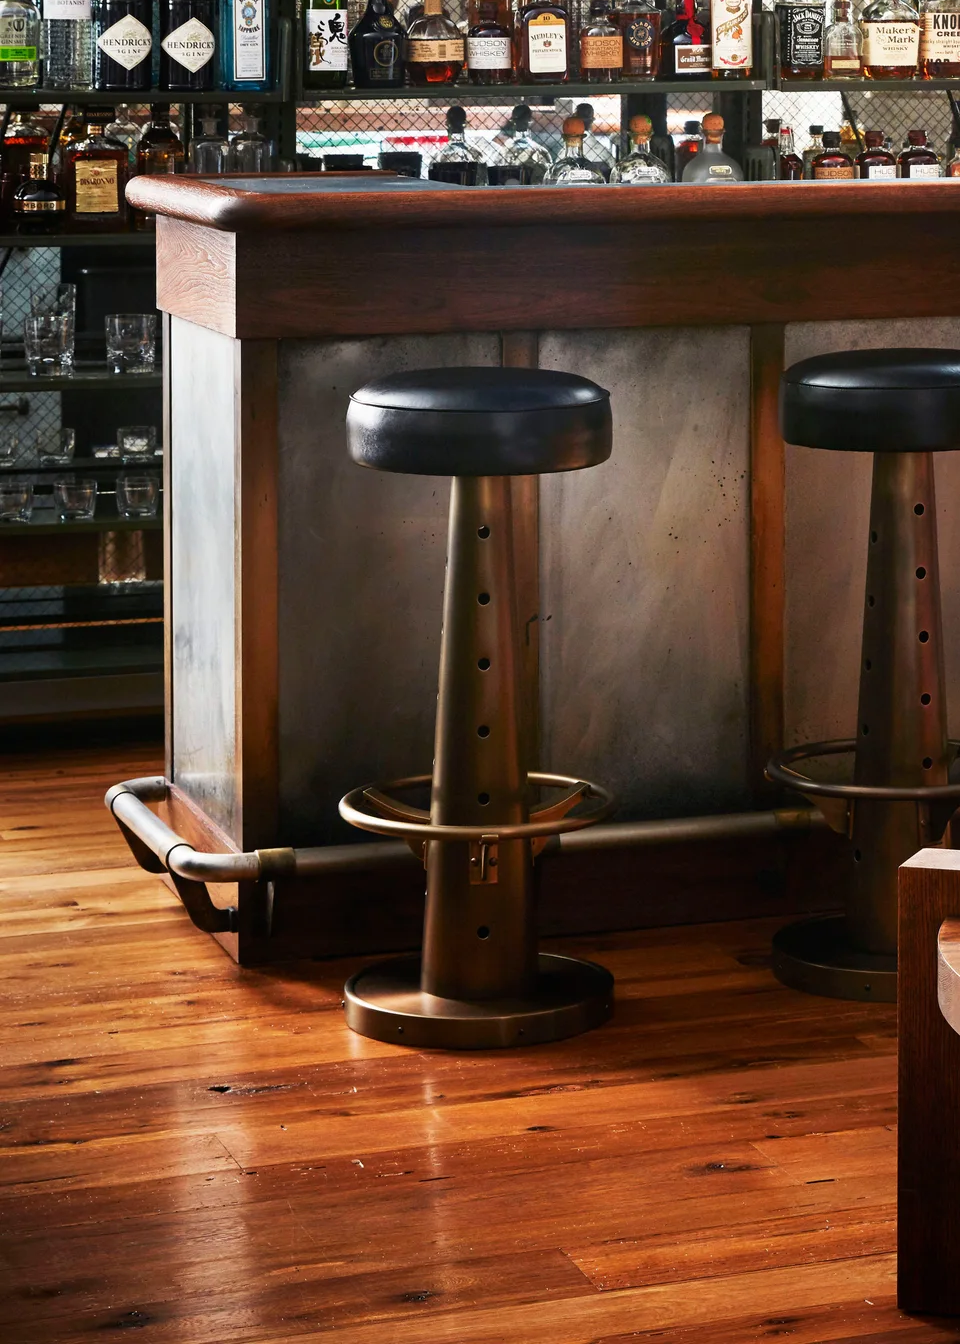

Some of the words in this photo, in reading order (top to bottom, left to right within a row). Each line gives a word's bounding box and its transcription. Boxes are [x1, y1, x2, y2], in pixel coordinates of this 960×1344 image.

[793, 12, 805, 23] JACK
[631, 22, 652, 30] BLADE
[103, 38, 151, 46] HENDRICK'S
[630, 36, 640, 46] AND
[641, 35, 653, 46] BOW
[80, 178, 115, 186] DISARONNO
